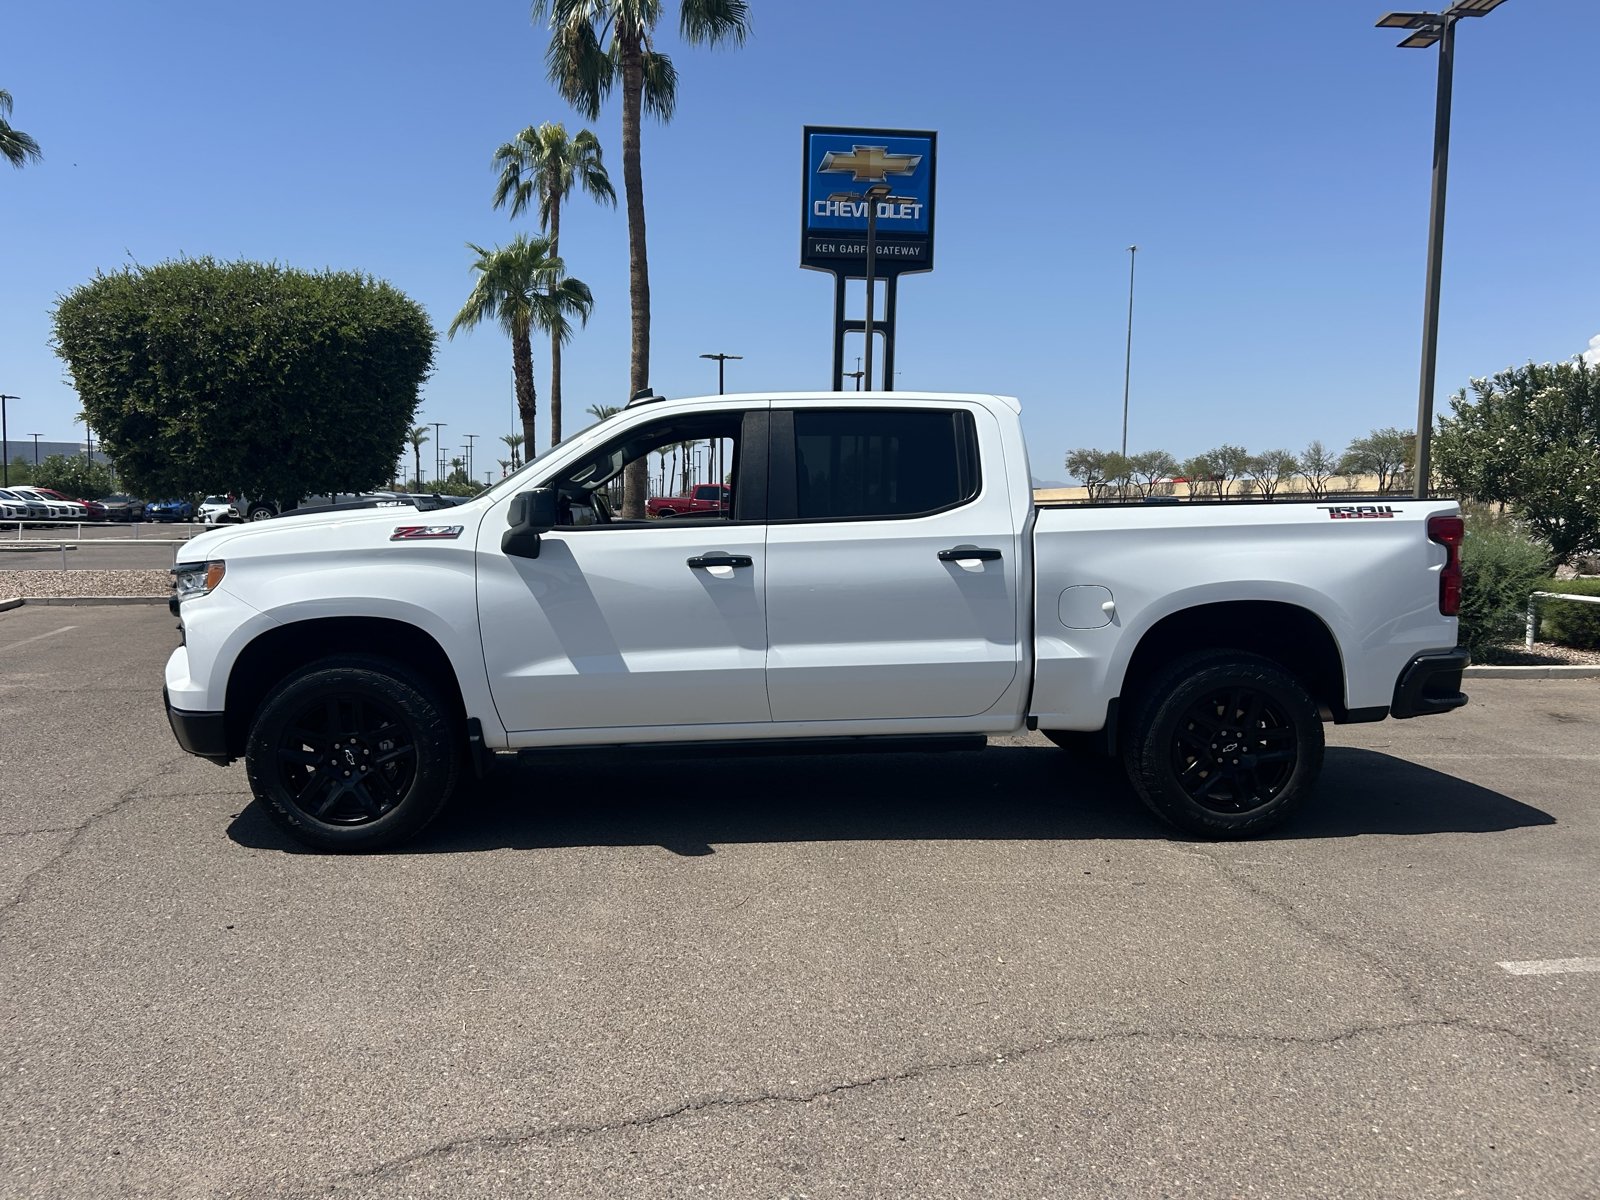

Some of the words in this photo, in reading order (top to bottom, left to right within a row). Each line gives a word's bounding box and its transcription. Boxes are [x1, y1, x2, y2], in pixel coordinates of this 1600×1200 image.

[815, 243, 835, 253] KEN
[839, 244, 870, 254] GARF
[875, 245, 920, 256] GATEWAY
[1317, 505, 1403, 513] TRAIL
[1330, 512, 1394, 520] BOSS
[390, 525, 464, 541] Z71
